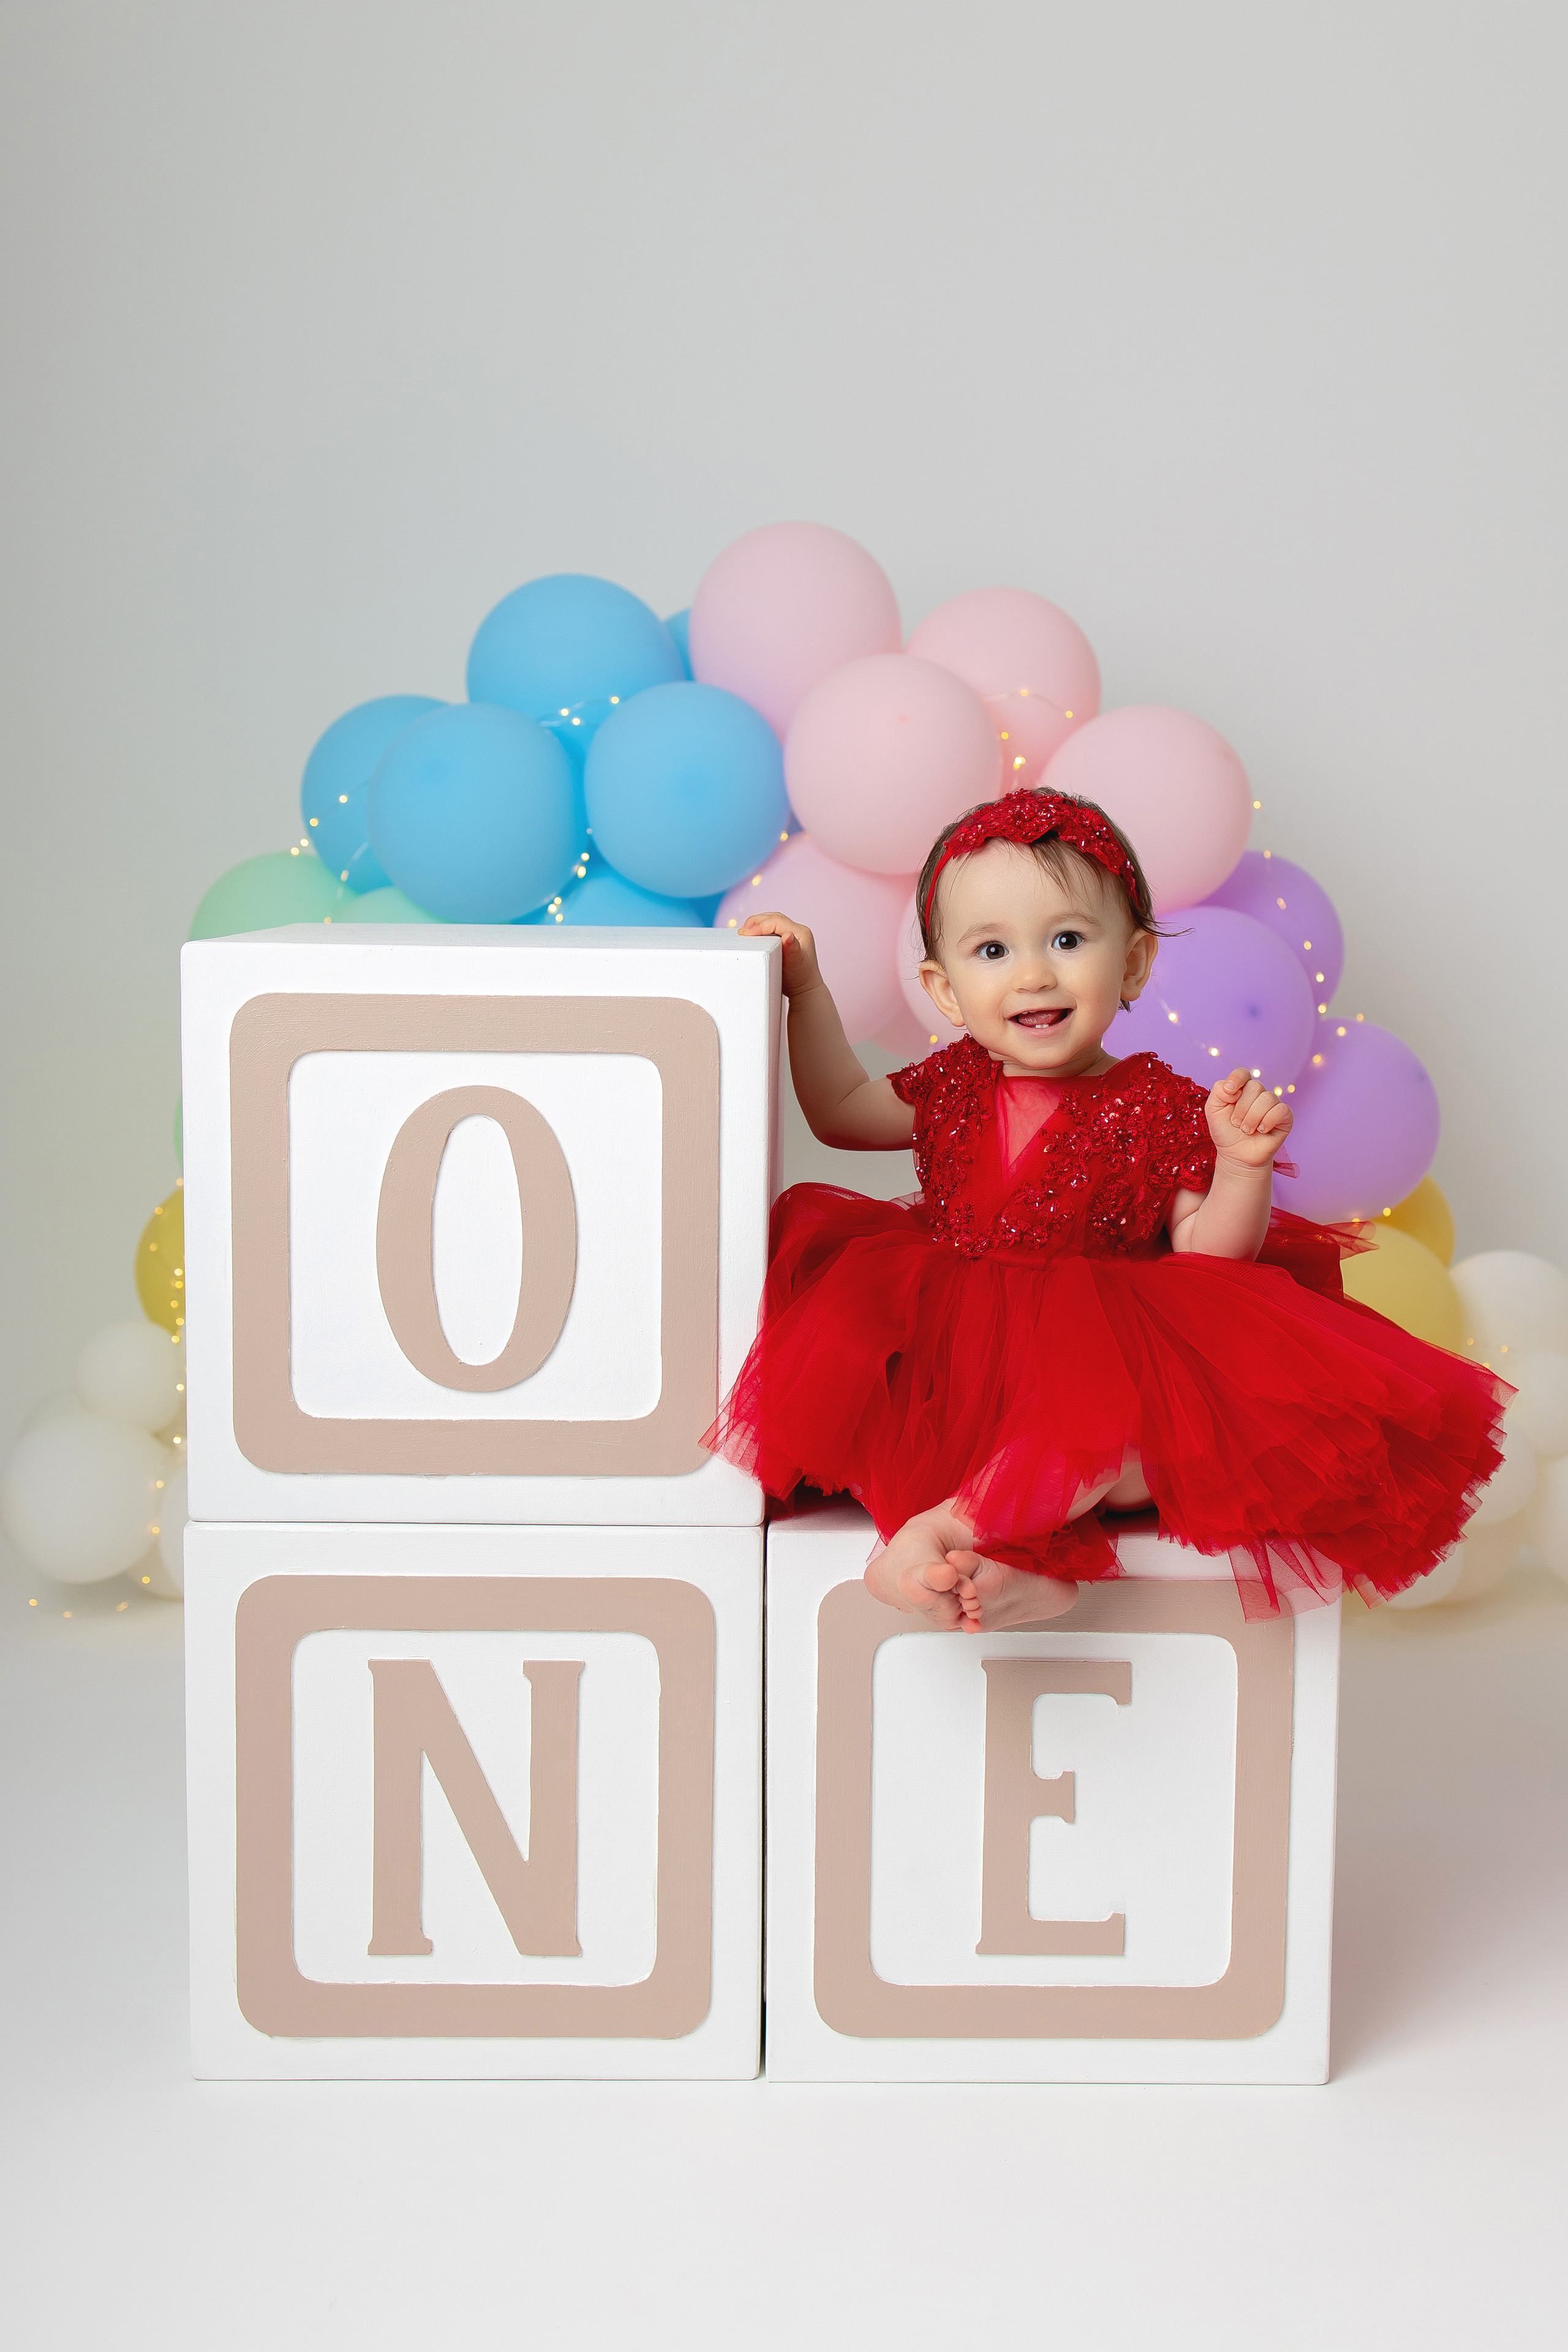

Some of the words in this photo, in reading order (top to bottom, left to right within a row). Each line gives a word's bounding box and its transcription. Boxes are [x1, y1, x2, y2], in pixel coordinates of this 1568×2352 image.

[375, 1085, 577, 1392] O
[367, 1659, 585, 1956] N
[975, 1658, 1132, 1956] E
